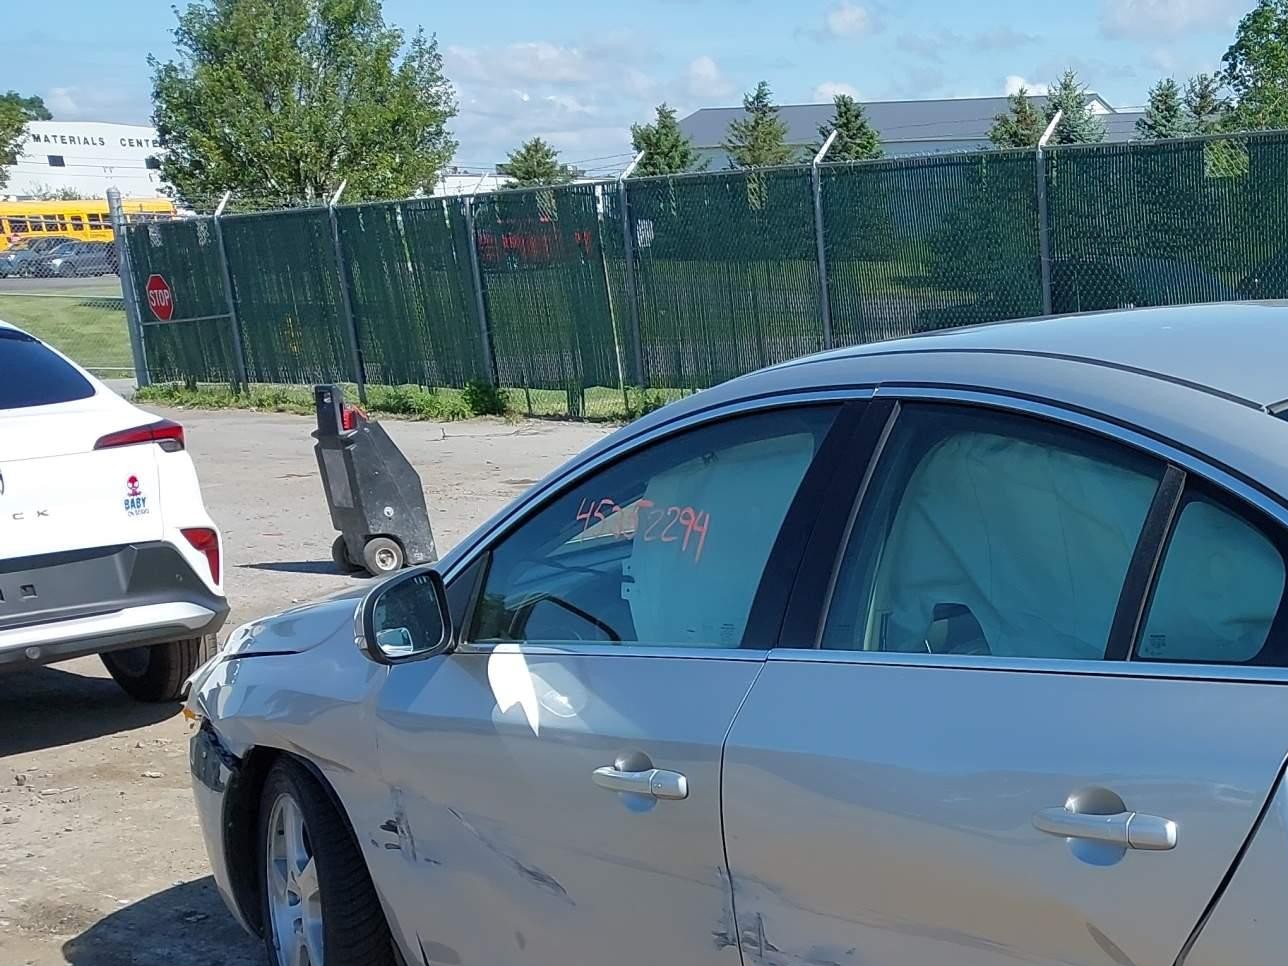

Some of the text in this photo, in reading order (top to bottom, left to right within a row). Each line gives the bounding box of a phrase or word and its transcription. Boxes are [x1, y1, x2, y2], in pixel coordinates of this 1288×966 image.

[32, 134, 105, 145] MATERIALS
[149, 290, 170, 306] STOP
[124, 497, 146, 508] BABY
